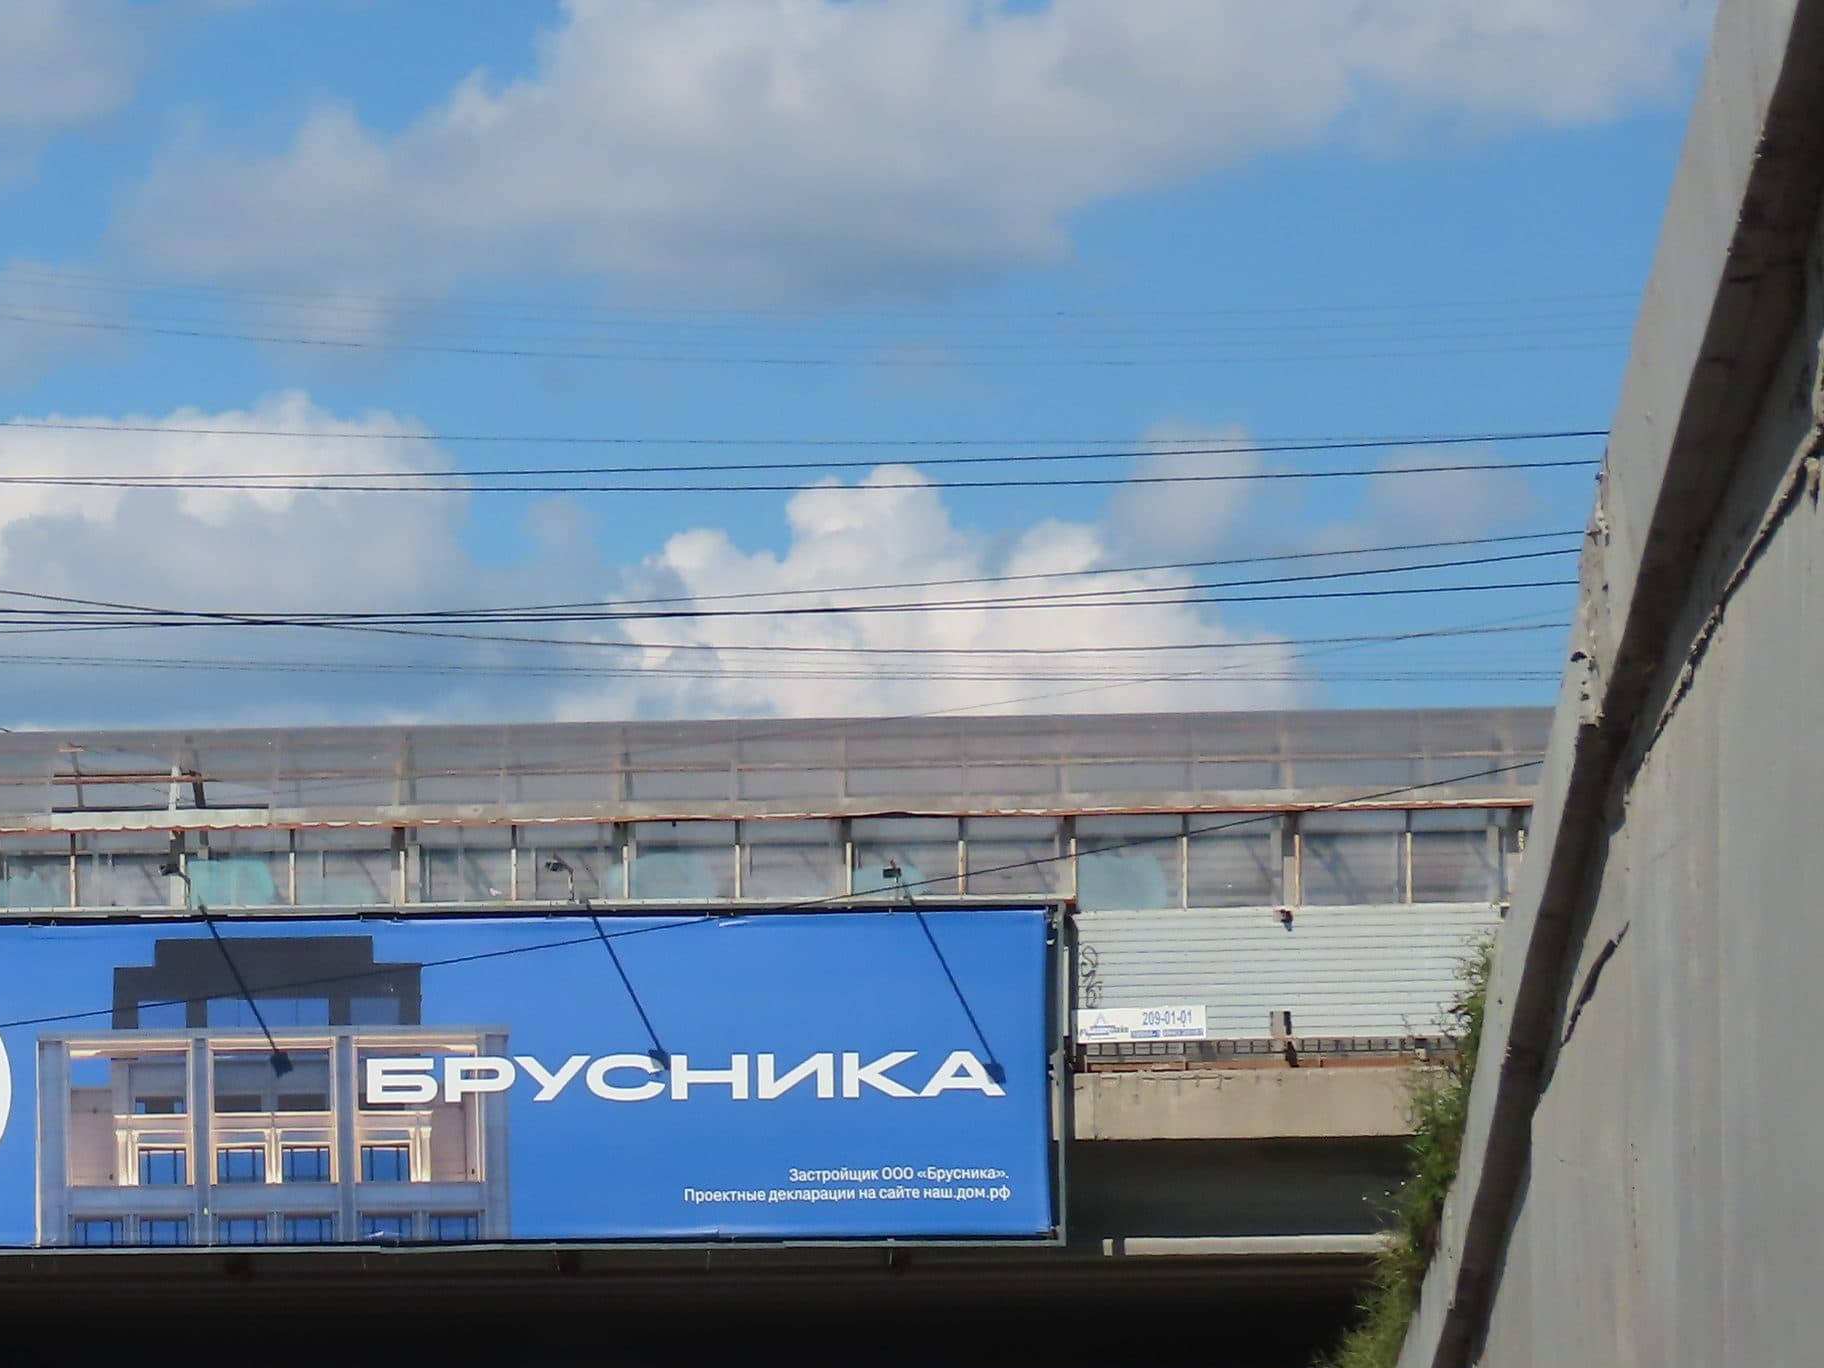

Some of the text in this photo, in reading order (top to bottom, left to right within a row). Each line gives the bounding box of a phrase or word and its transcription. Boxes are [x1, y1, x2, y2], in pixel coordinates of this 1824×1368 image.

[366, 1050, 1006, 1105] БРУСНИКА
[789, 1167, 878, 1182] Застройщик
[882, 1167, 914, 1180] ООО
[684, 1186, 1011, 1203] Проектные декларации на сайте наш.дом.рф
